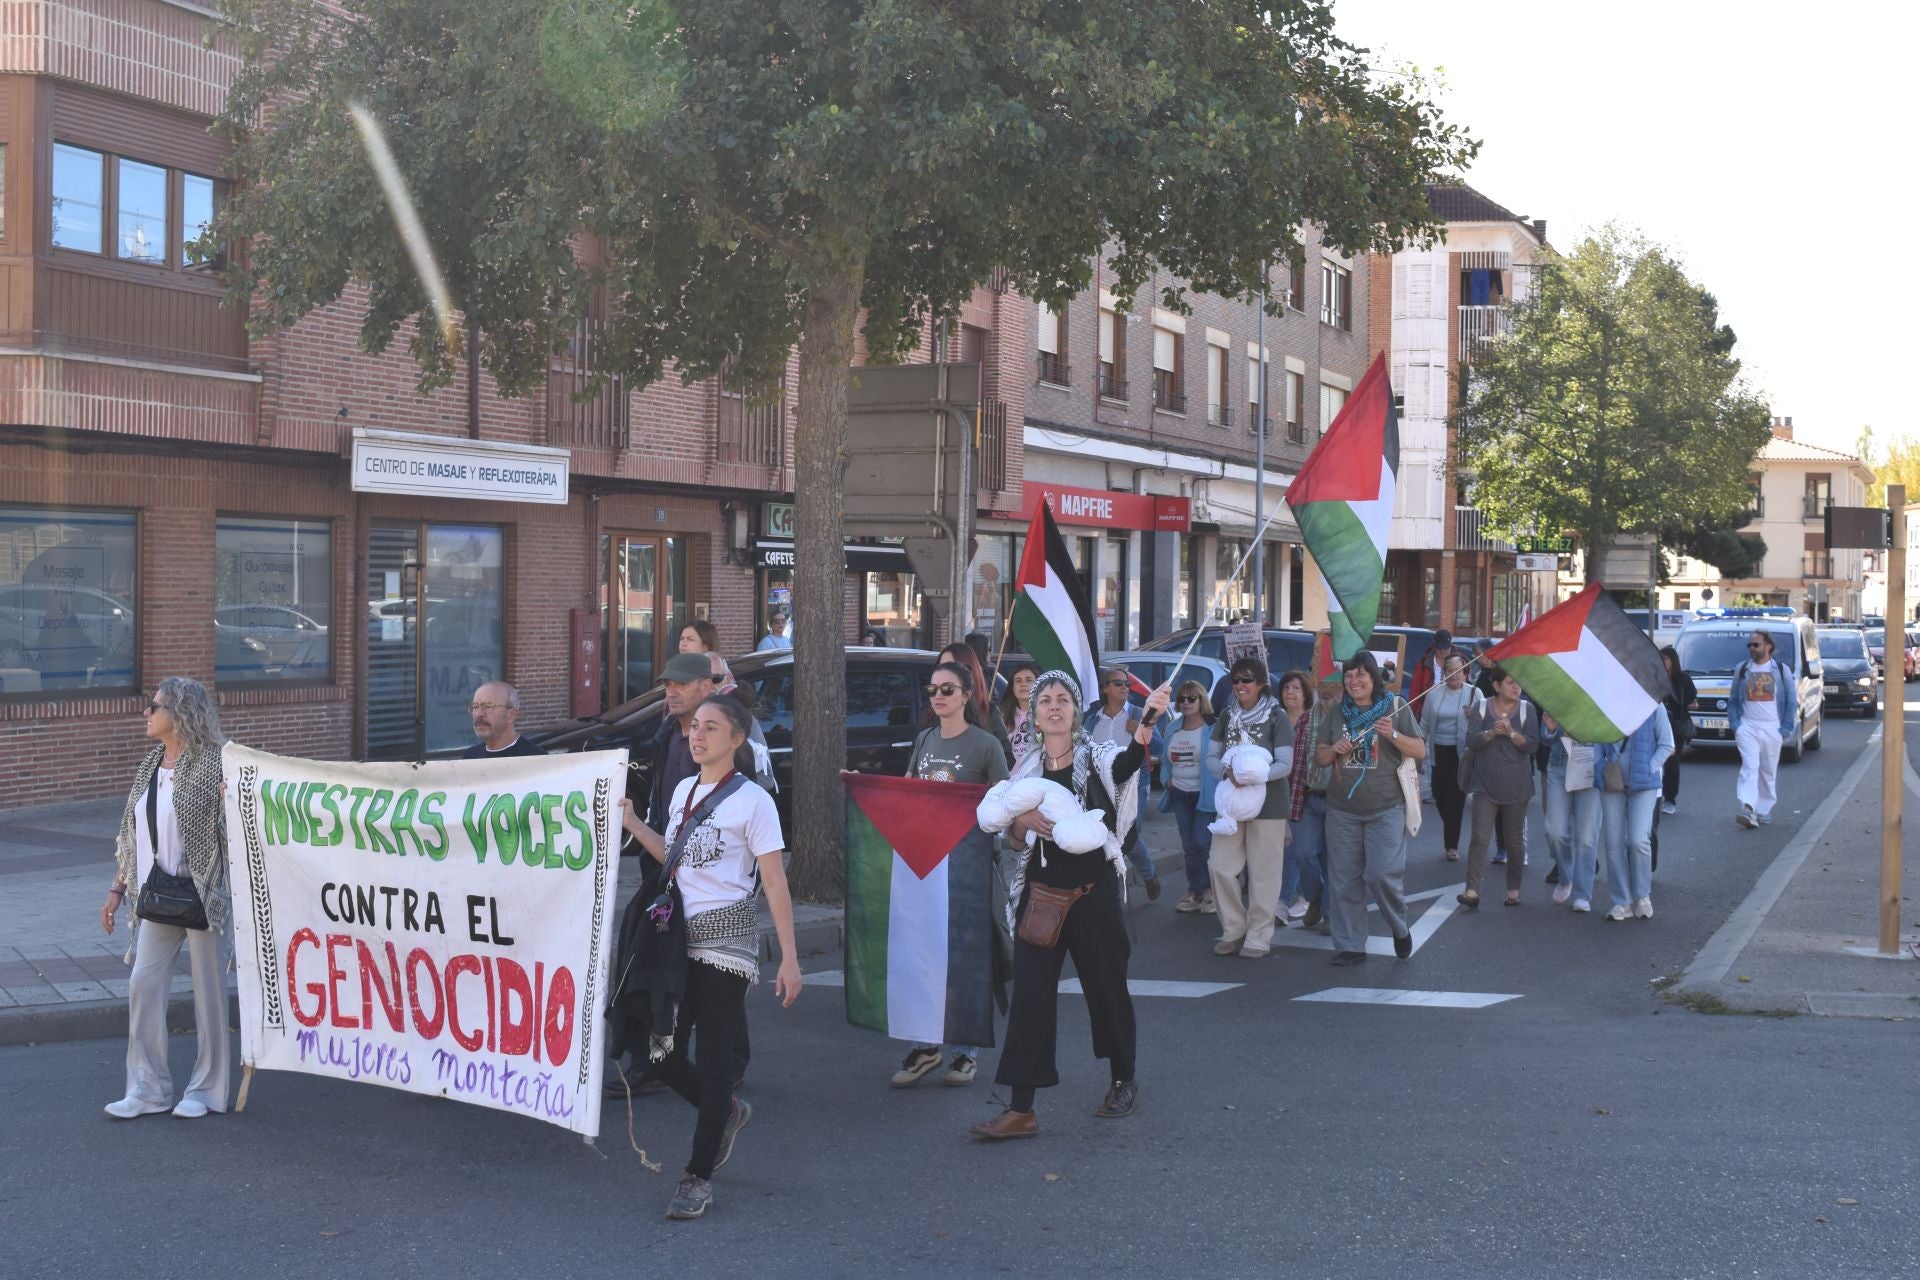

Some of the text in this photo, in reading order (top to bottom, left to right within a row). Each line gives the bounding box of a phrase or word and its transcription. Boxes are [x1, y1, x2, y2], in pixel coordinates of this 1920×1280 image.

[365, 457, 558, 486] CENTRO DE MASAJE Y REFLEXOTERÁPIA
[1061, 494, 1113, 519] MAPFRE
[43, 564, 85, 580] Masaje
[260, 779, 594, 871] NUESTRAS VOCES
[320, 881, 515, 946] CONTRA EL
[286, 927, 576, 1068] GENOCIDIO
